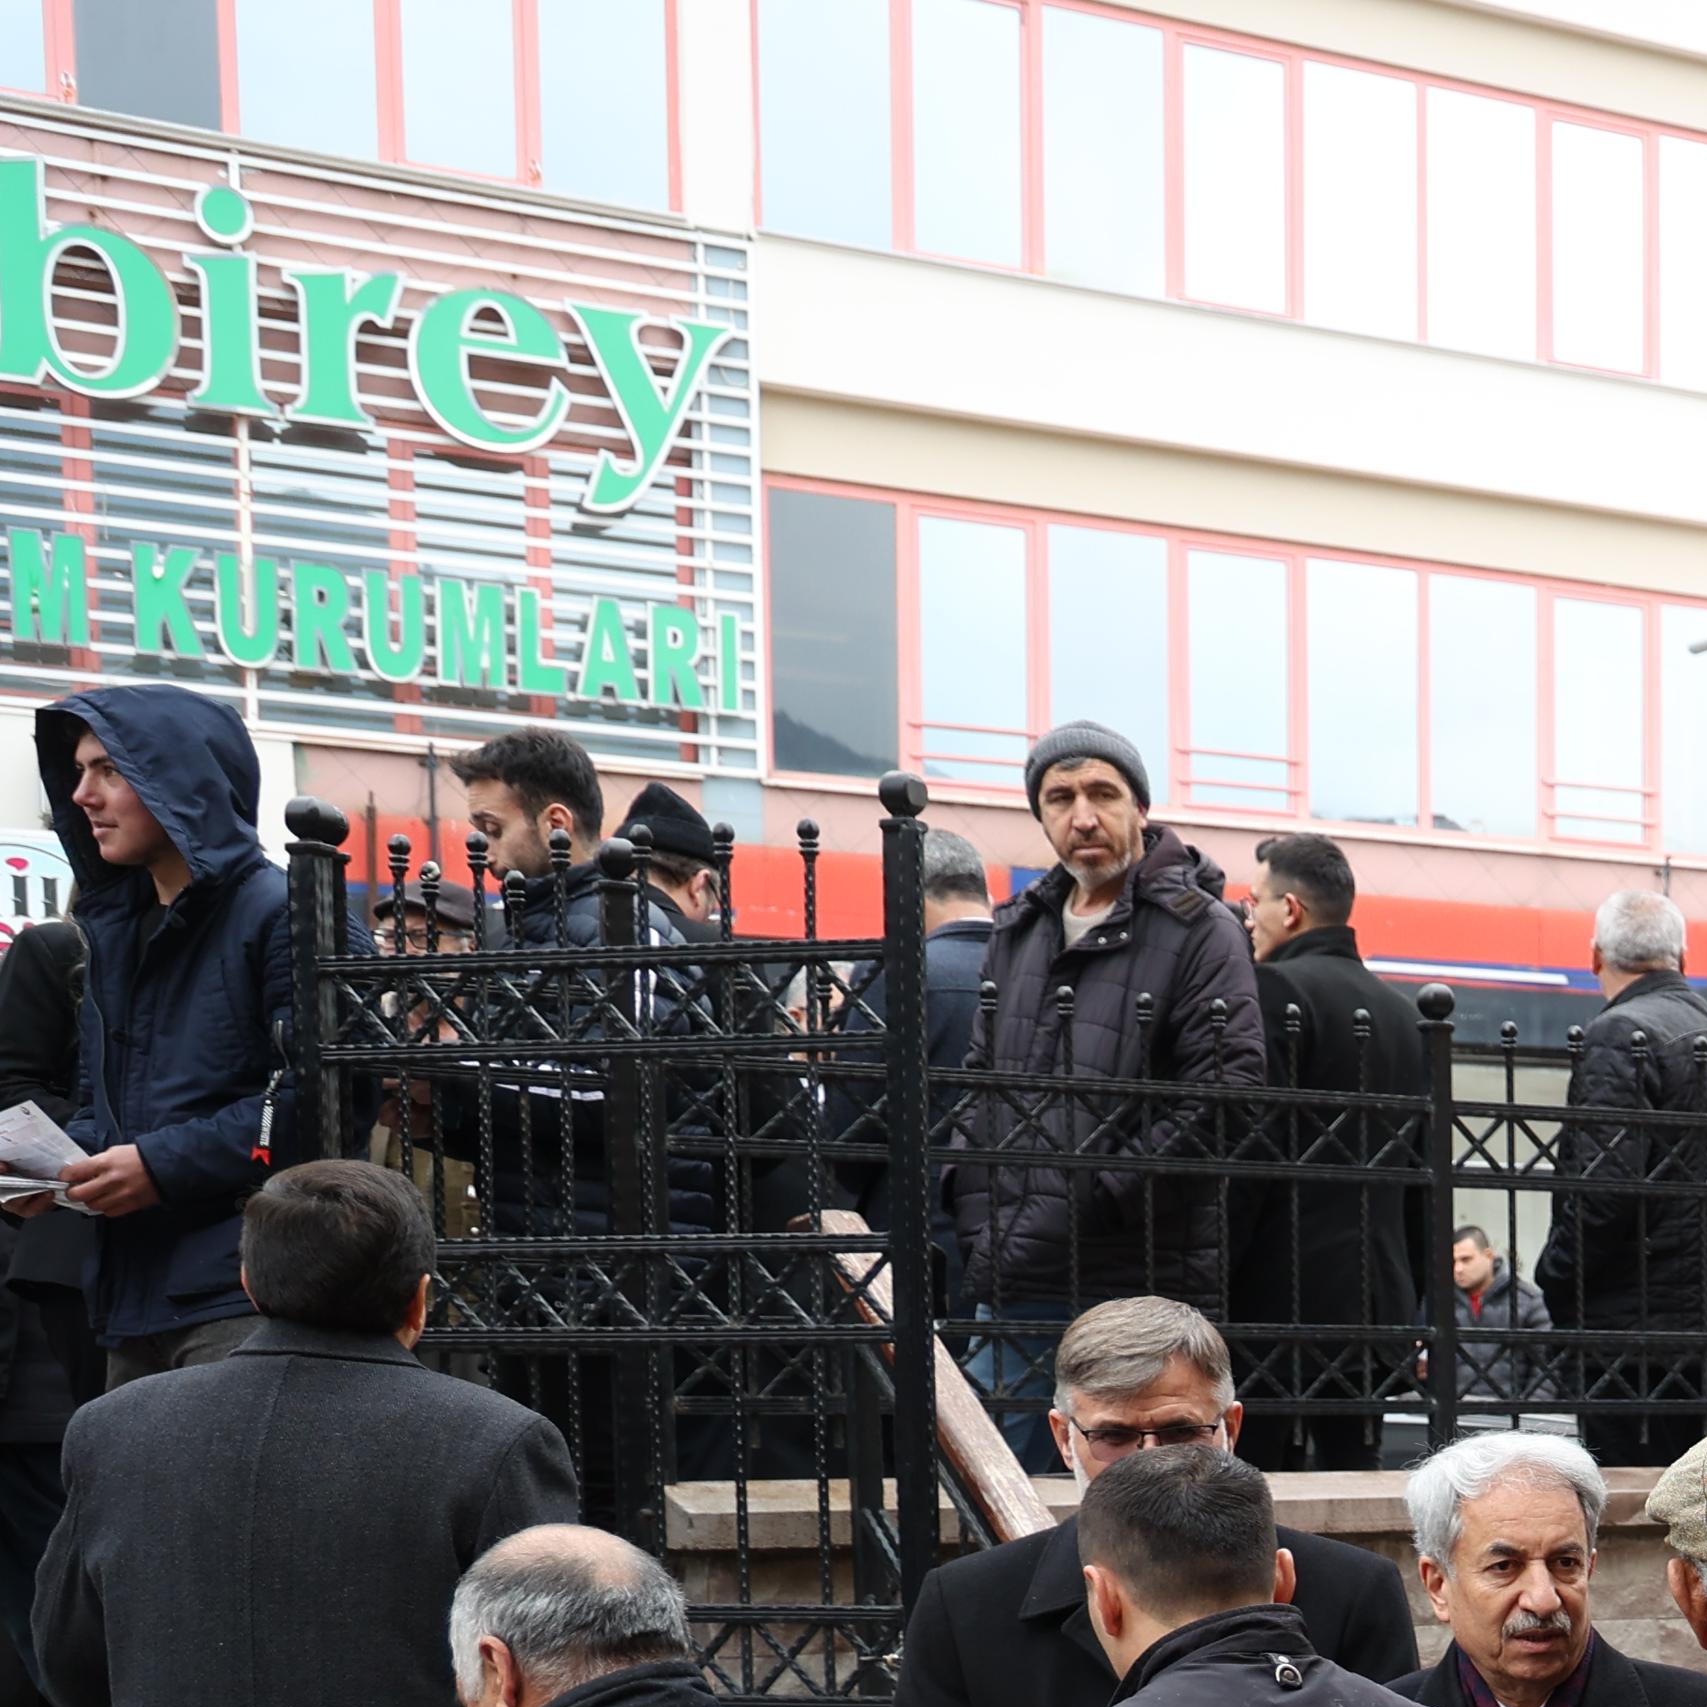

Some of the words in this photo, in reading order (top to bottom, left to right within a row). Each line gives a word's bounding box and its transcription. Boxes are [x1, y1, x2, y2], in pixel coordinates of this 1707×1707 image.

[0, 156, 735, 516] birey
[7, 527, 89, 647] M
[131, 541, 741, 712] KURUMLARI
